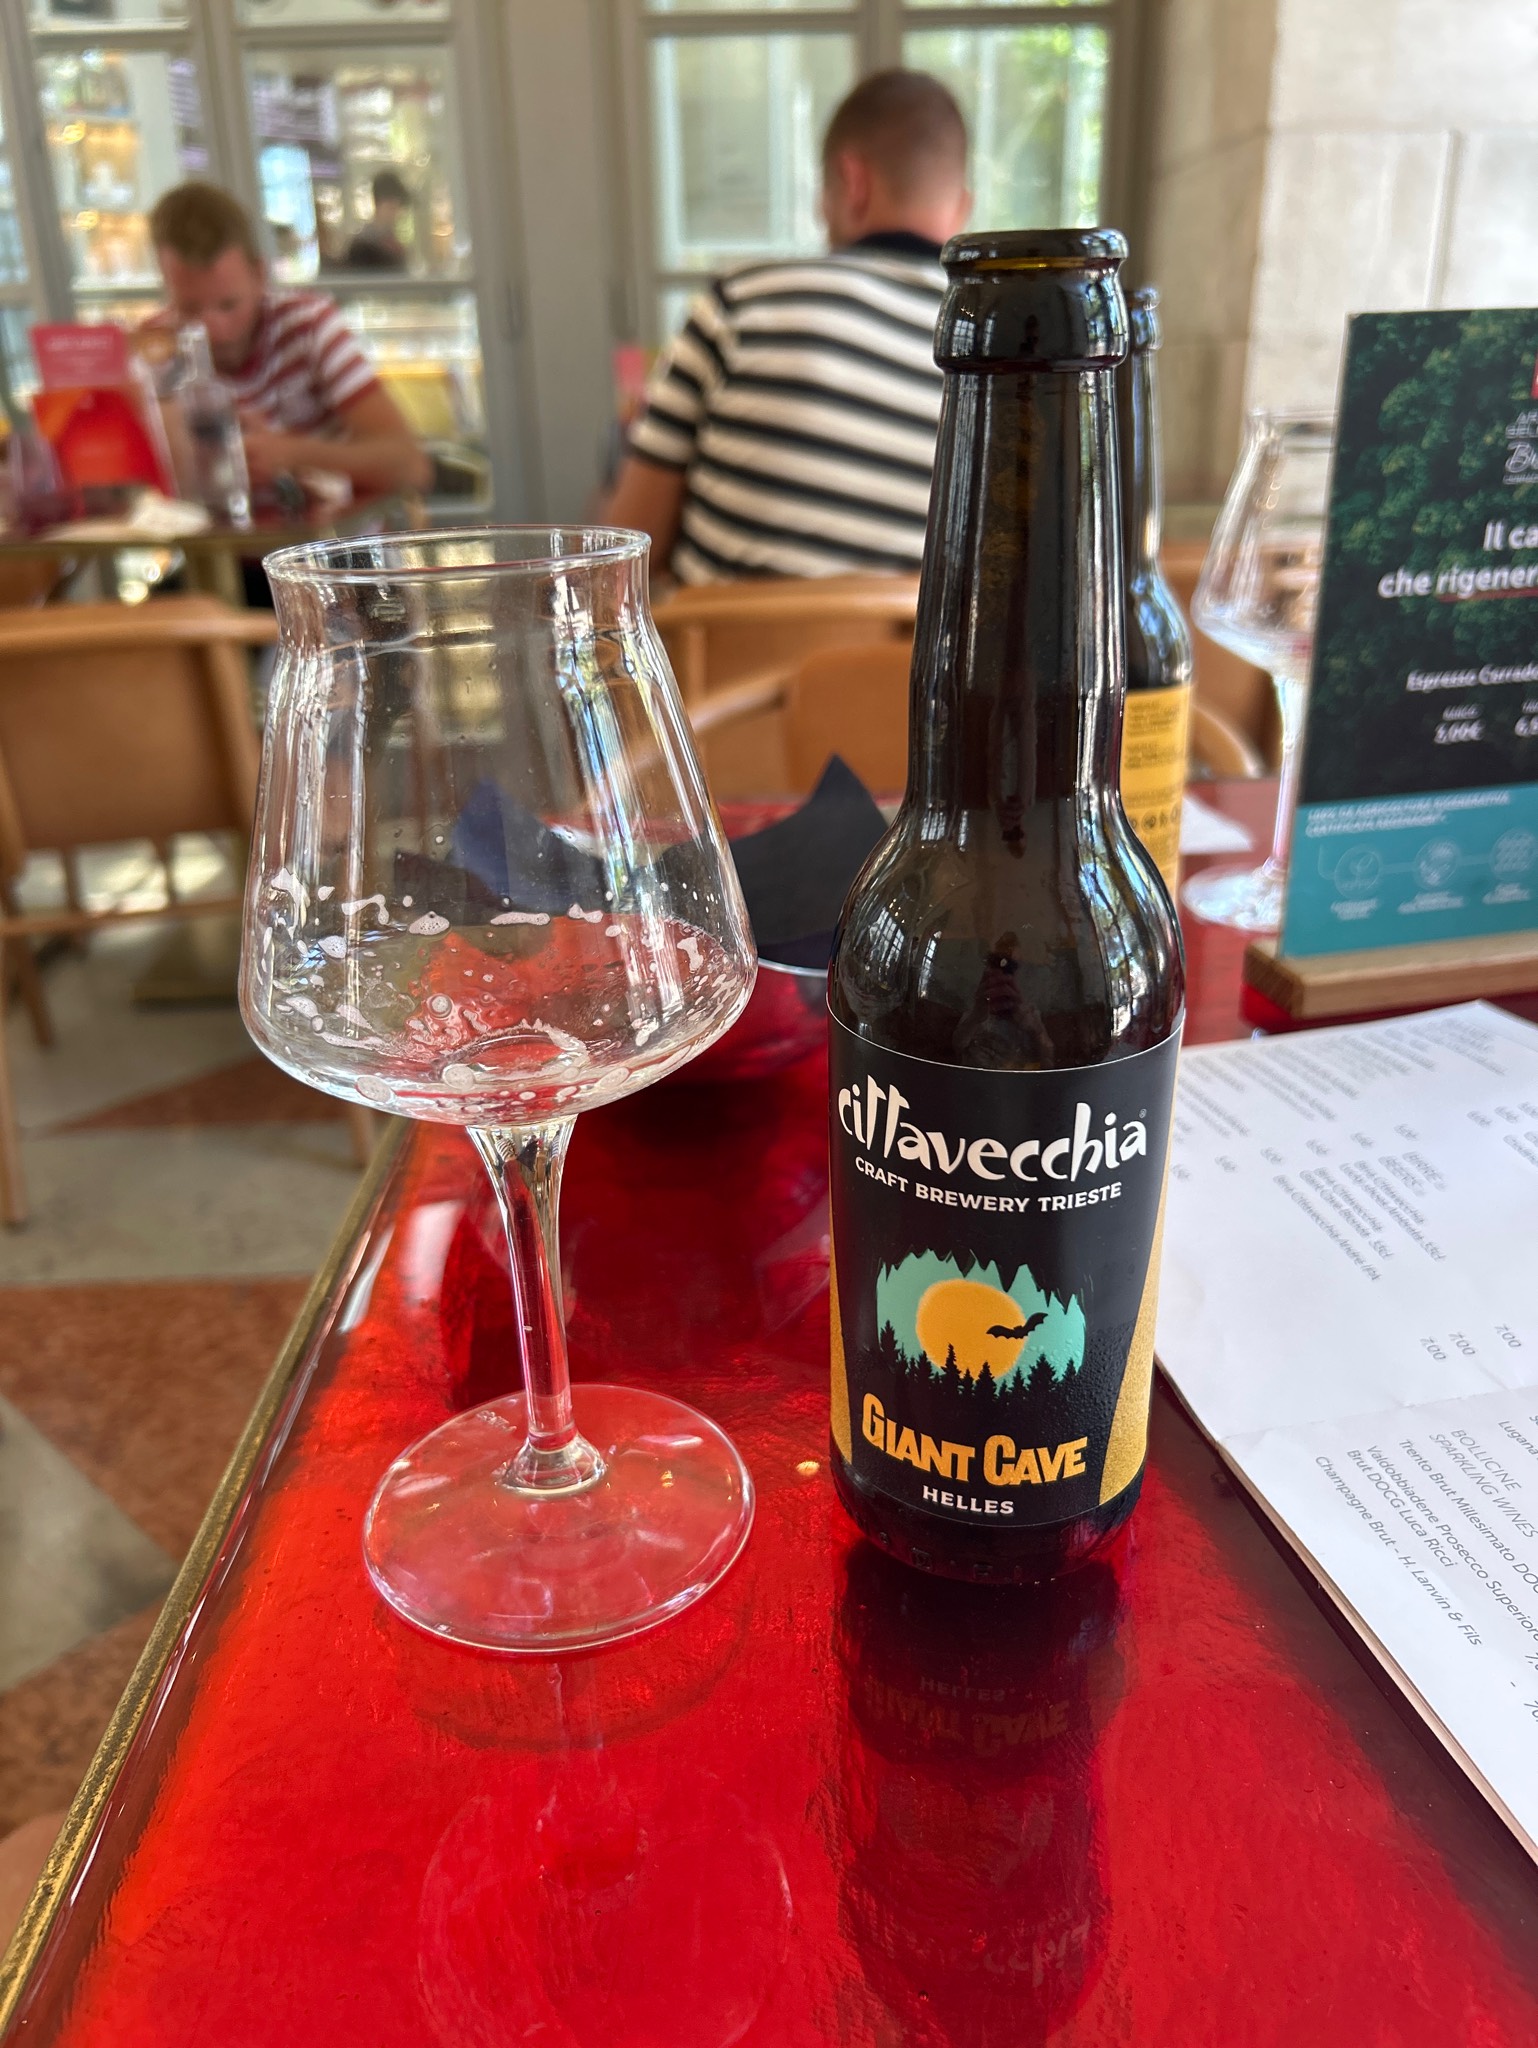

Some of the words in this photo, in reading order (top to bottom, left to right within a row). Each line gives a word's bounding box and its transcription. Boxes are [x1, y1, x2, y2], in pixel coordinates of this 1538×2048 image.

[1378, 567, 1431, 598] che
[855, 1156, 909, 1193] CRAFT
[915, 1182, 1030, 1213] BREWERY
[1038, 1181, 1123, 1212] TRIESTE
[862, 1393, 975, 1482] GIANT
[983, 1434, 1088, 1486] CAVE
[1429, 1433, 1499, 1495] SPARKLING
[1492, 1496, 1537, 1539] WINES
[1451, 1429, 1522, 1491] BOLLICINE
[922, 1485, 1014, 1515] HELLES
[1347, 1449, 1368, 1474] Brut
[1366, 1471, 1402, 1510] DOCG
[1398, 1508, 1427, 1538] Luca
[1423, 1537, 1458, 1568] Ricci
[1366, 1445, 1439, 1524] Valdobbiadene
[1437, 1523, 1488, 1579] Prosecco
[1399, 1438, 1432, 1472] Trento
[1429, 1472, 1457, 1498] Brut
[1451, 1497, 1515, 1562] Millesimato
[1315, 1455, 1373, 1521] Champagne
[1368, 1520, 1397, 1548] Brut
[1398, 1554, 1416, 1571] H.
[1411, 1569, 1452, 1610] Lanvin
[1447, 1611, 1462, 1622] &
[1458, 1623, 1482, 1647] Fils
